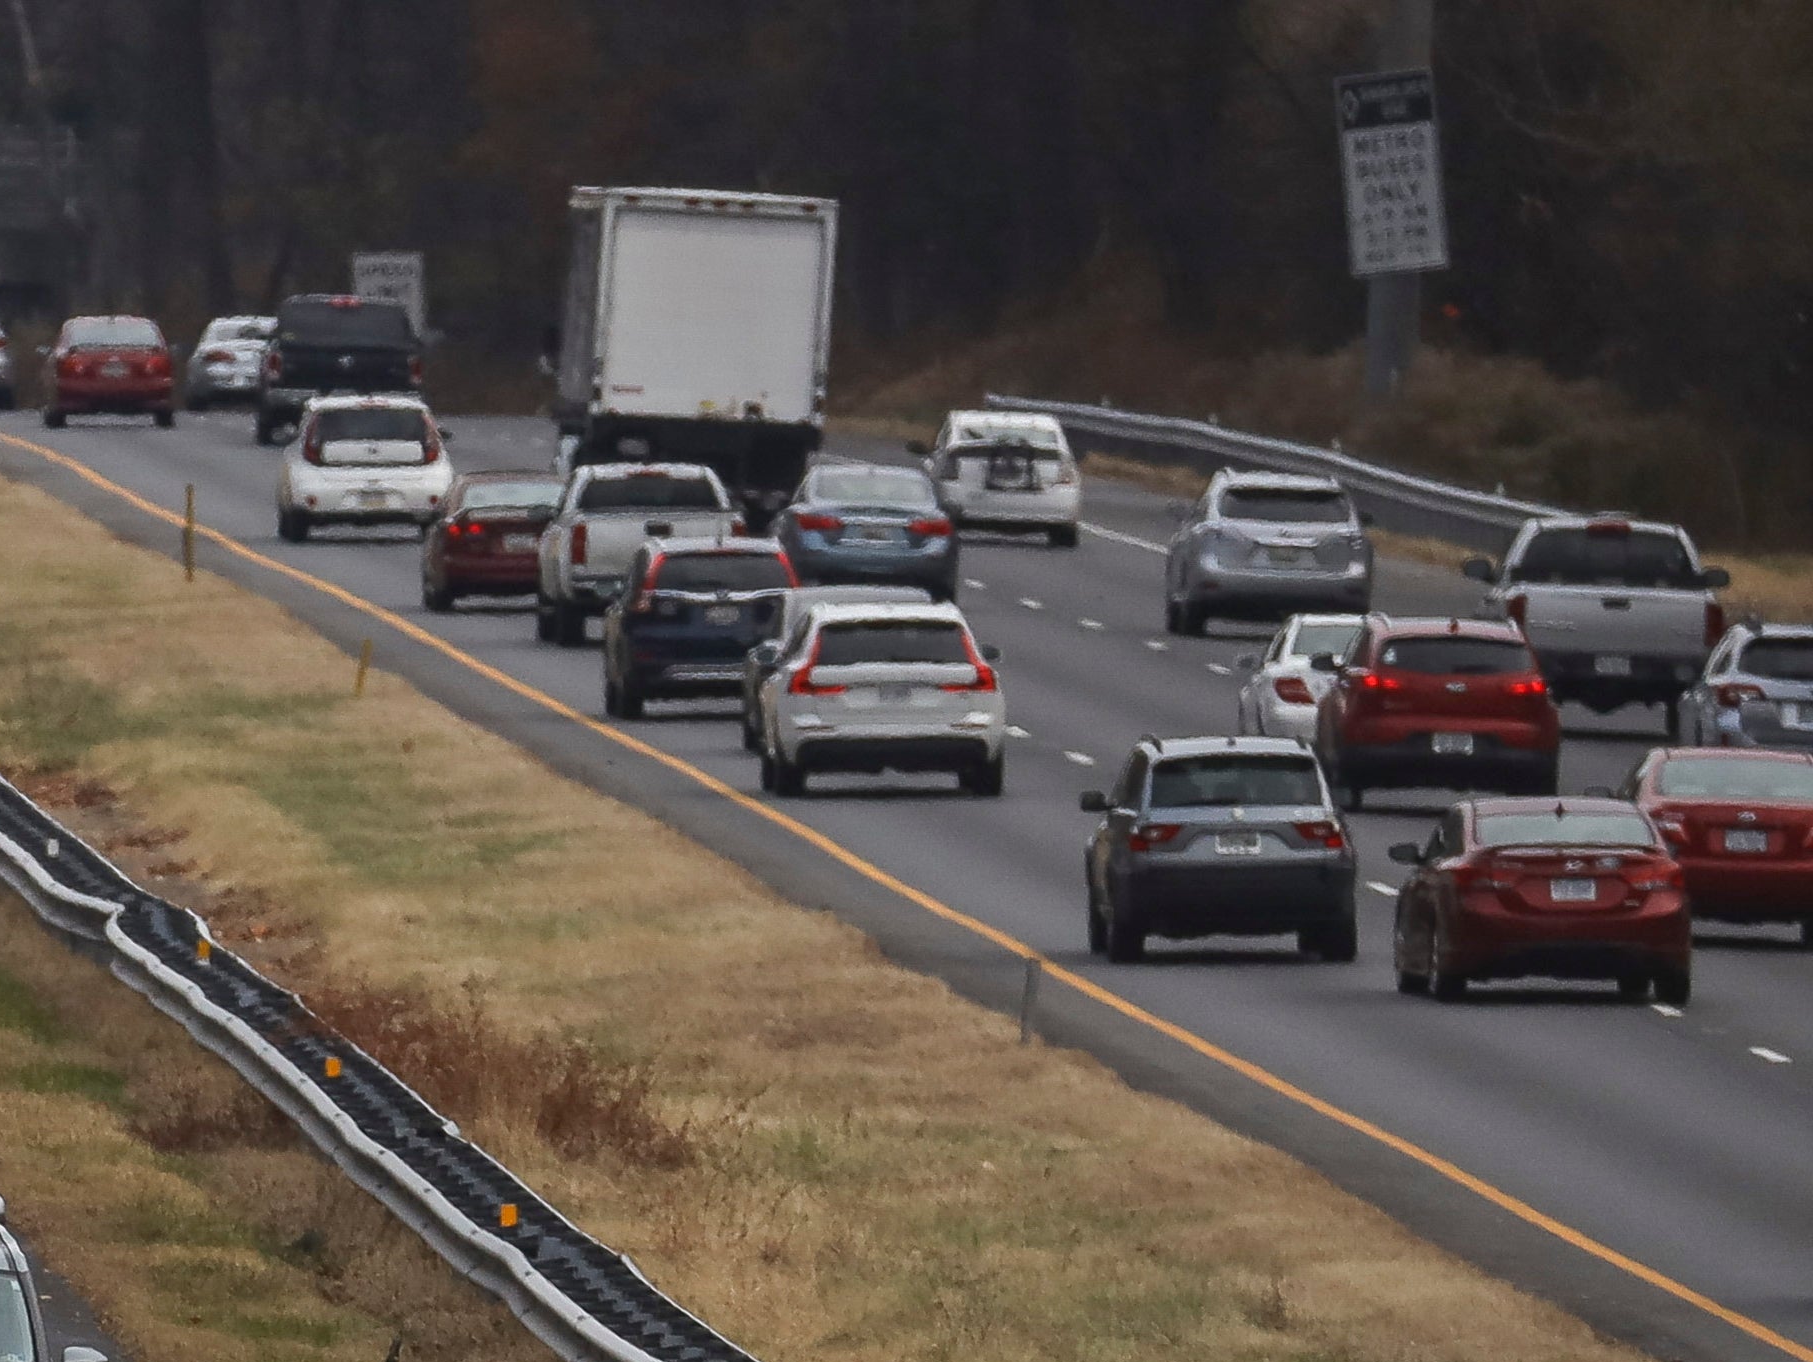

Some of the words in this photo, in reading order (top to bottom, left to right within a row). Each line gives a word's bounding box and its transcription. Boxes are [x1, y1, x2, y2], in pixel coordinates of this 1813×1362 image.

[1354, 128, 1425, 154] METRO
[1356, 154, 1426, 180] BUSES
[1364, 179, 1423, 204] ONLY
